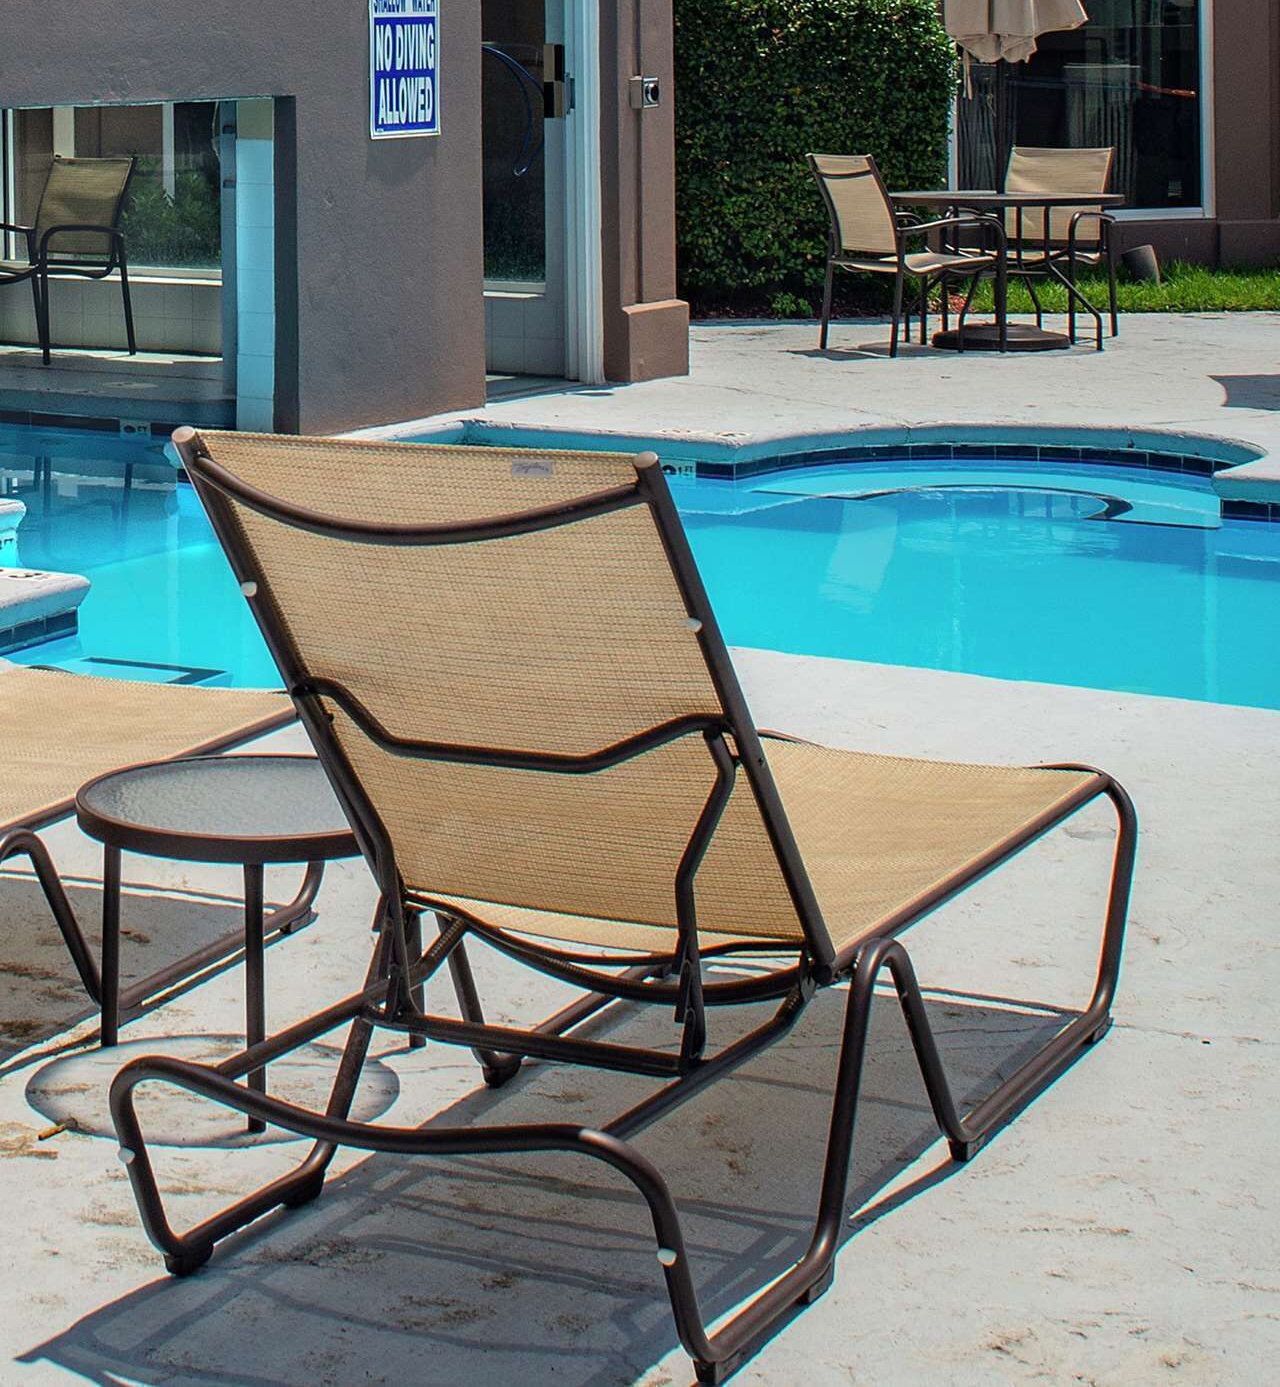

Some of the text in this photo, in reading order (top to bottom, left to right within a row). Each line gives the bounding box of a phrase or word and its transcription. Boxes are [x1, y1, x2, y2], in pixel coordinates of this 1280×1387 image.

[375, 23, 435, 71] NO DIVING
[378, 76, 433, 125] ALLOWED
